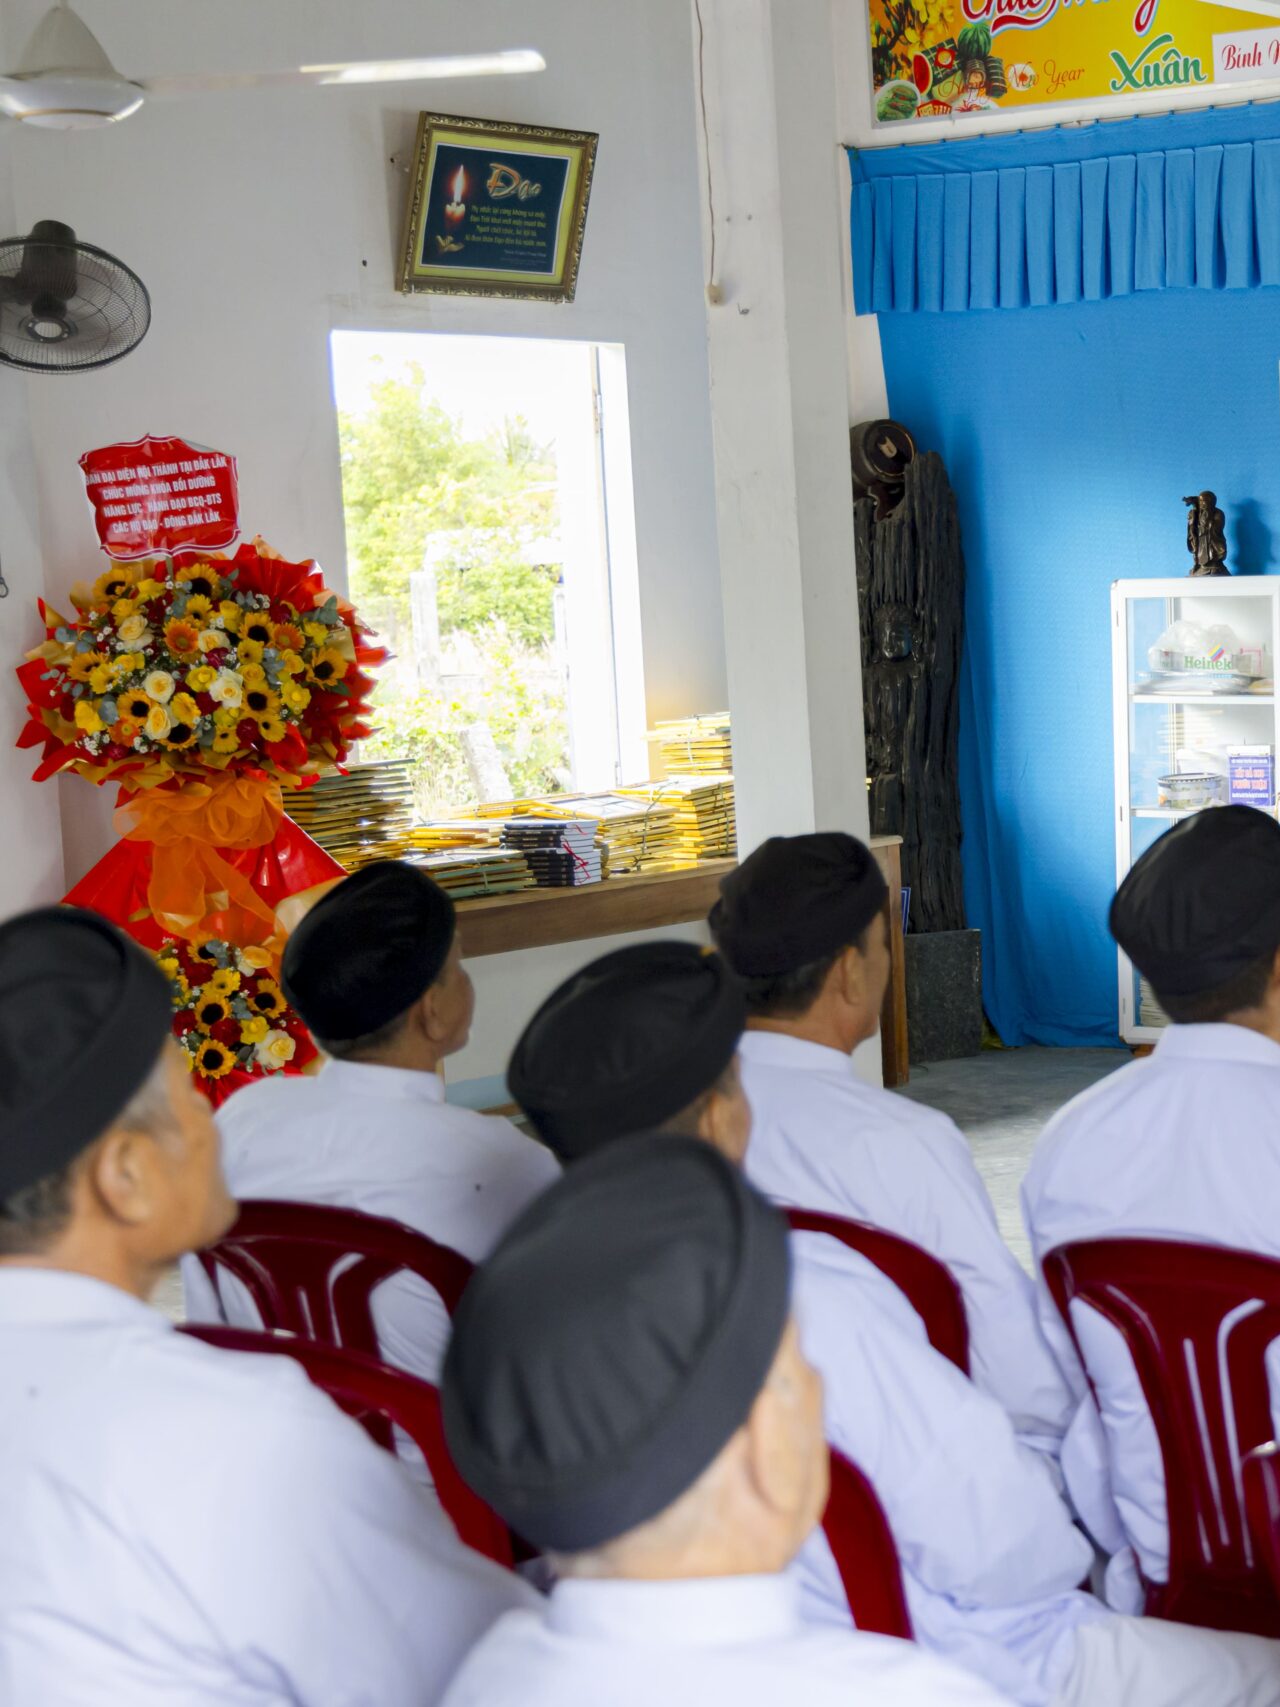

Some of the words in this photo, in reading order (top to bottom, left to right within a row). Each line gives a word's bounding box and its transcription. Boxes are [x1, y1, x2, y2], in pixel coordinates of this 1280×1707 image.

[1110, 33, 1206, 92] Xuân
[1221, 44, 1264, 71] Bính
[1005, 61, 1040, 89] New
[1043, 60, 1085, 94] Year
[117, 467, 136, 482] DIỆN
[152, 463, 178, 476] THÁNH
[179, 460, 192, 475] TẠI
[102, 485, 125, 500] CHÚC
[126, 482, 149, 497] MỪNG
[150, 480, 172, 495] KHÓA
[189, 475, 216, 490] DƯỠNG
[103, 504, 126, 518] NĂNG
[128, 501, 143, 516] LỰC
[147, 498, 170, 513] HÀNH
[170, 497, 187, 512] ĐẠO
[112, 519, 129, 533] CÁC
[130, 519, 141, 533] HỌ
[164, 514, 187, 529] ĐÔNG
